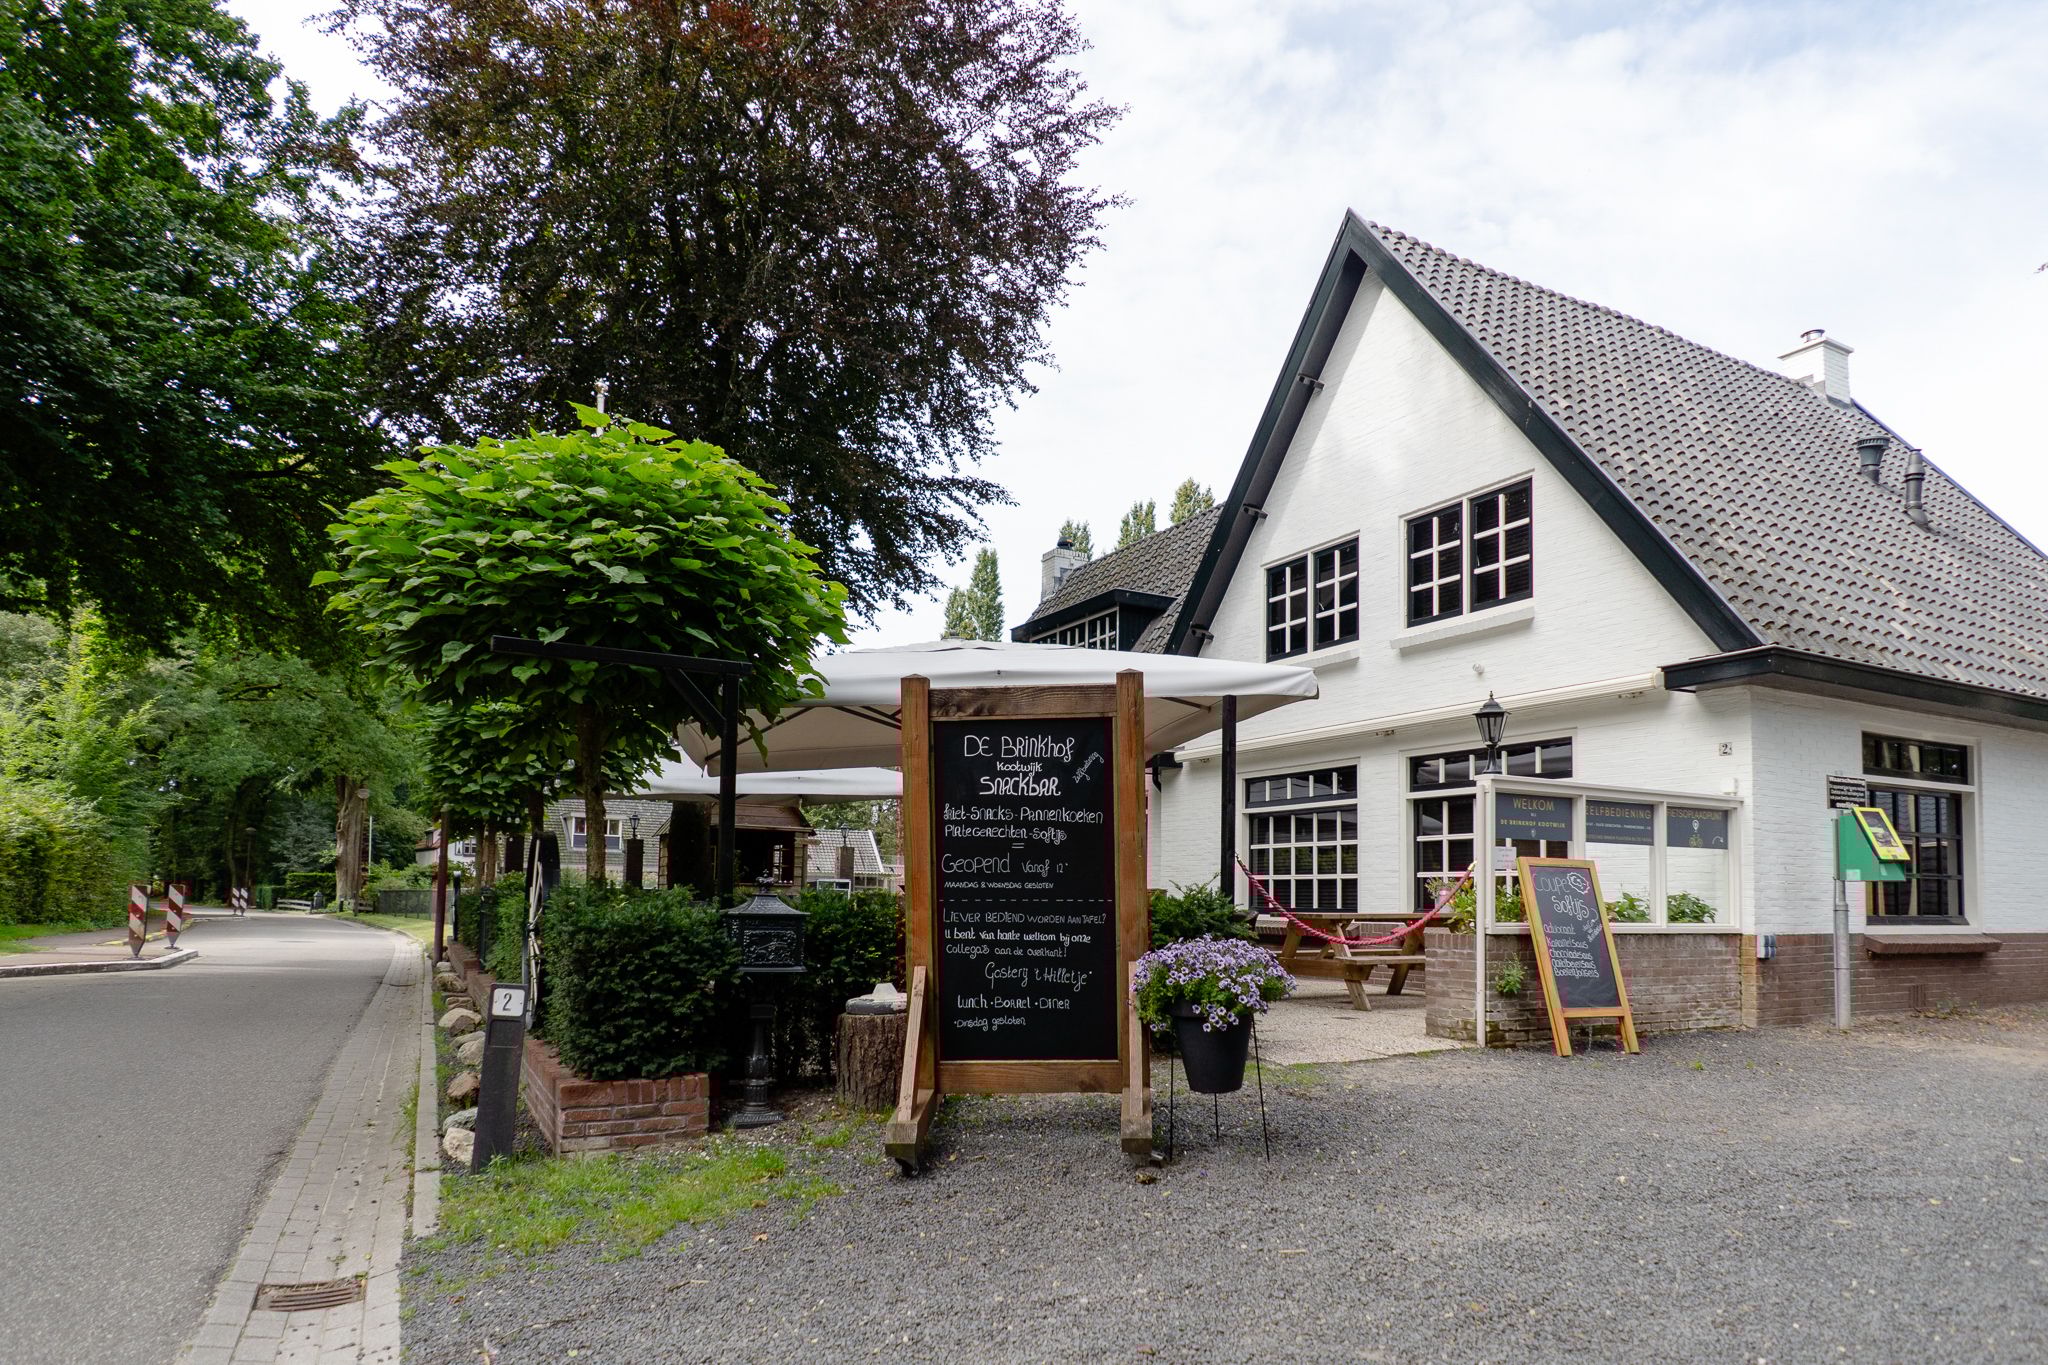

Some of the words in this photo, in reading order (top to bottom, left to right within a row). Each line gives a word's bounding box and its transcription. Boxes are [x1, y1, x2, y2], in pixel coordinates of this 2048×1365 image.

[1512, 797, 1555, 811] WELKOM
[1026, 914, 1065, 924] WORDEN
[1067, 914, 1081, 924] AAN
[997, 928, 1021, 940] harte
[1023, 931, 1056, 941] welkom
[1060, 932, 1070, 947] bij
[1071, 934, 1091, 943] onze
[994, 947, 1012, 955] aan
[1013, 946, 1024, 956] de
[503, 992, 512, 1011] 2
[991, 1015, 1026, 1031] gesloten
